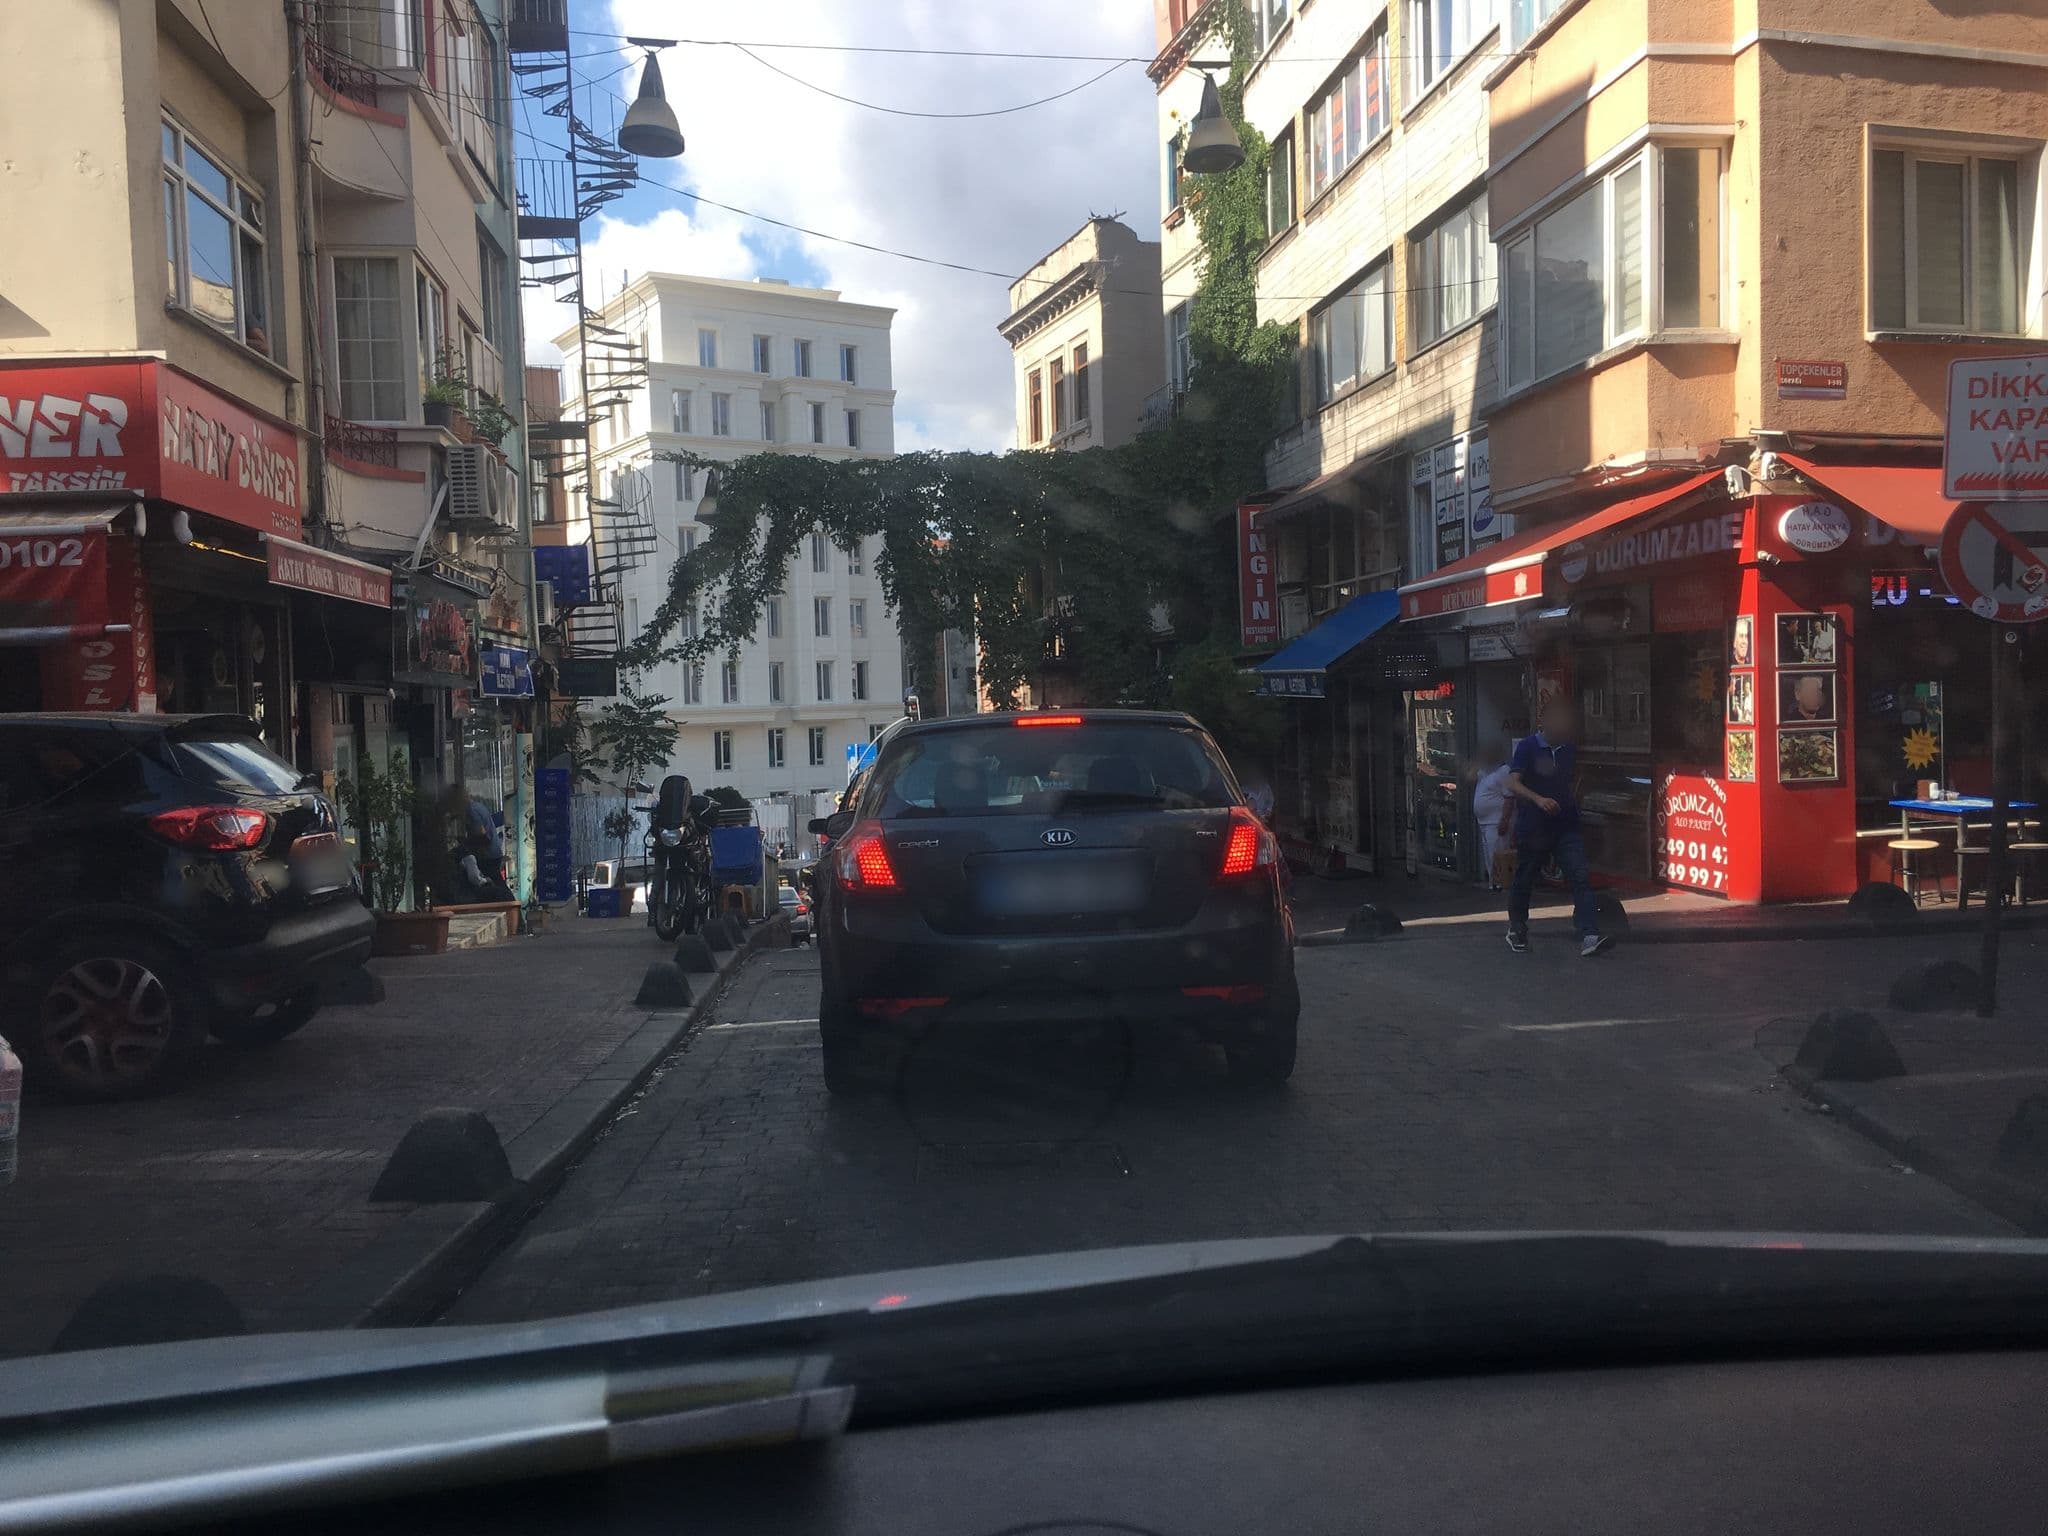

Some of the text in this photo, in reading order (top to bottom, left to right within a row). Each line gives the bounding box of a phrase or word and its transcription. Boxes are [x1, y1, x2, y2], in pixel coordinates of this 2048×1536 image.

[1780, 364, 1843, 377] TOPÇEKENLER
[1967, 372, 2048, 399] DİKK
[163, 396, 296, 509] HATAY DÖNER
[277, 557, 305, 585] HATAY
[306, 560, 335, 591] DÖNER
[1048, 832, 1072, 844] KIA
[1657, 837, 1686, 857] 249
[1688, 841, 1707, 860] 01
[1659, 859, 1727, 889] 249 99 7
